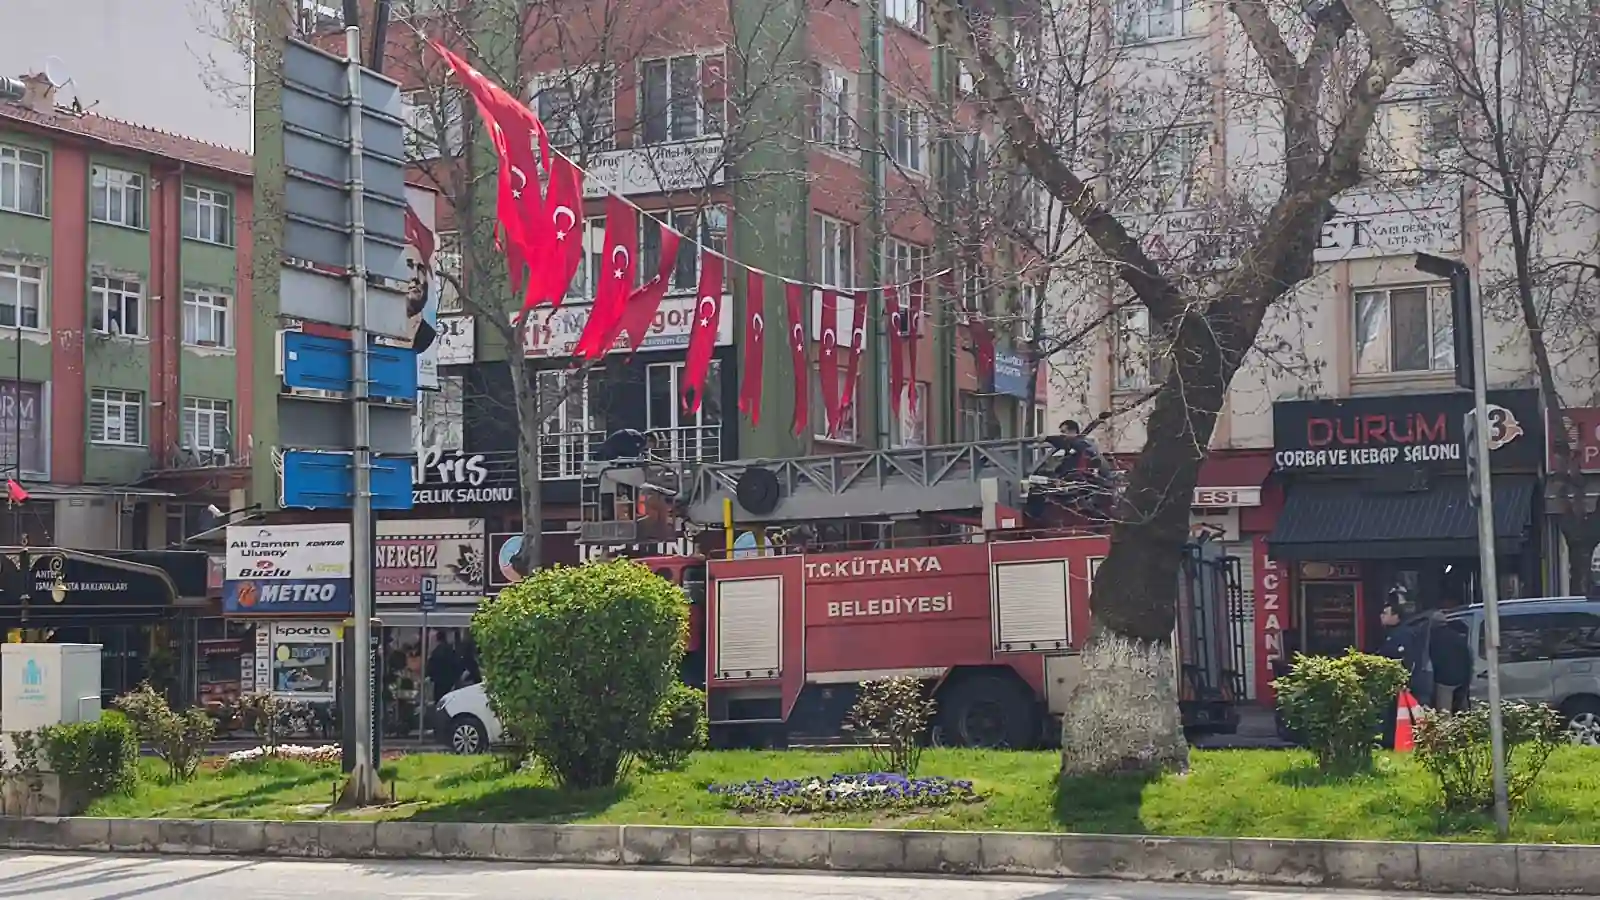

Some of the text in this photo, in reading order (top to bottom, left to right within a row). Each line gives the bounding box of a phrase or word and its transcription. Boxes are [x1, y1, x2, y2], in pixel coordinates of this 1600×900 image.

[1319, 220, 1371, 248] ET
[1328, 450, 1349, 466] VE
[1351, 448, 1400, 465] KEBAP
[1404, 443, 1461, 462] SALONU
[412, 487, 513, 504] ZELLIK SALONU
[231, 541, 299, 549] Ali Osman
[241, 549, 287, 558] Ulusoy
[239, 568, 291, 577] Buzlu
[260, 584, 337, 602] METRO
[425, 579, 433, 592] D
[828, 592, 953, 617] BELEDİYESİ
